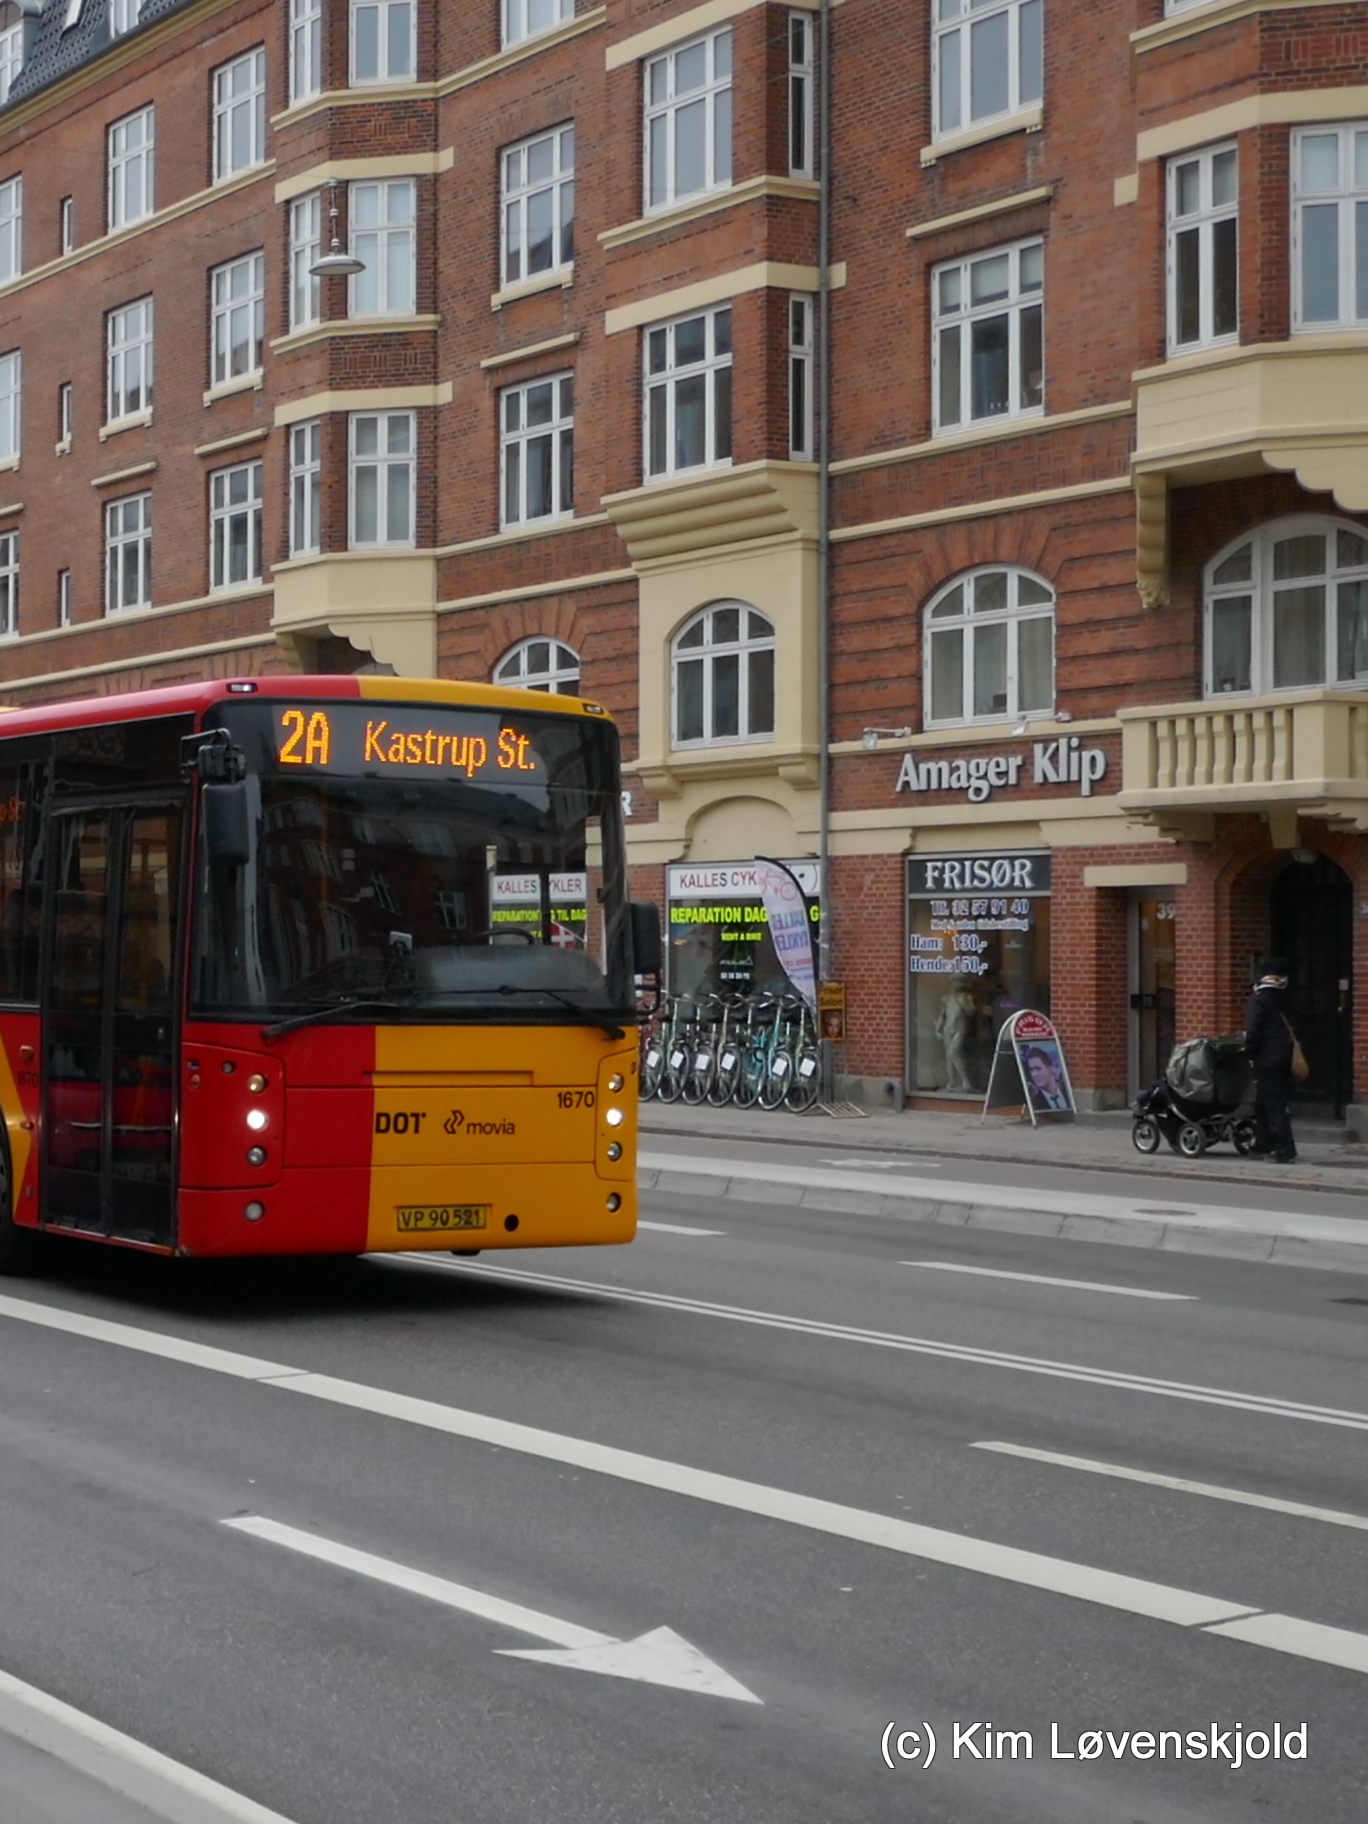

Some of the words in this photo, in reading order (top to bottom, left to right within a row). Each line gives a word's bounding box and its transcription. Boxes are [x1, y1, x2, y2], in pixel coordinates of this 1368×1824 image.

[279, 710, 329, 765] 2A
[364, 720, 486, 777] Kastrup
[497, 727, 536, 770] St.
[895, 753, 1023, 802] Amager
[1033, 737, 1106, 796] Klip
[679, 872, 728, 888] KALLES
[924, 858, 1034, 891] FRISØR
[497, 880, 537, 894] KALLES
[670, 906, 741, 924] REPARATION
[1156, 902, 1176, 920] 39
[556, 1091, 595, 1109] 1670
[374, 1112, 424, 1135] DOT
[466, 1118, 515, 1135] movia
[401, 1210, 425, 1228] VP
[428, 1209, 450, 1227] 90
[453, 1208, 481, 1227] 521
